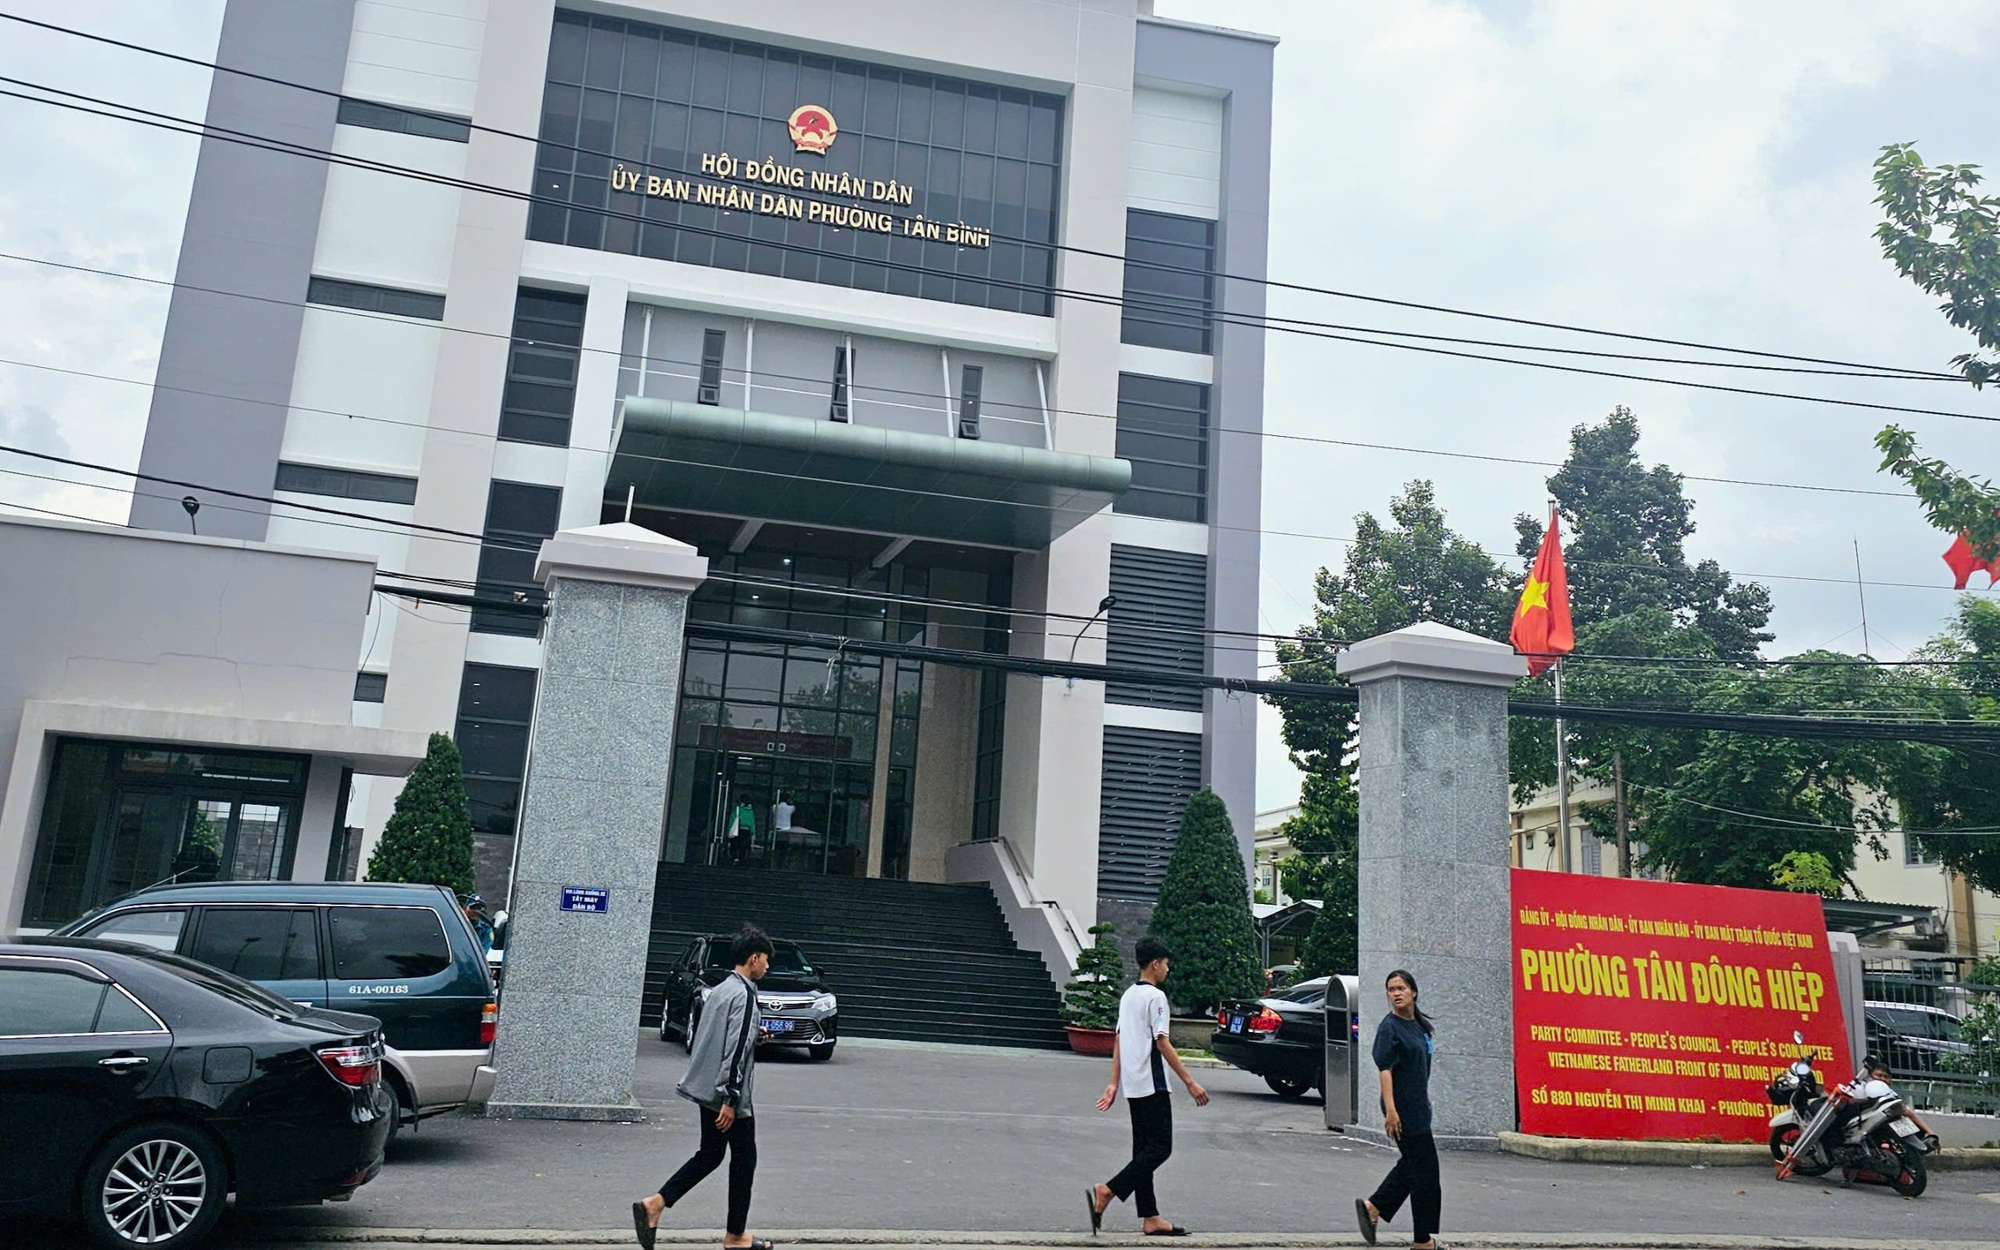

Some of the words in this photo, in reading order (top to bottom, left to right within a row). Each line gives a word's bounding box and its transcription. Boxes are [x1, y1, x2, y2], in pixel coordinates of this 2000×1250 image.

[702, 153, 738, 179] HỘI
[746, 156, 805, 187] ĐỒNG
[811, 171, 866, 197] NHÂN
[872, 179, 913, 205] DÂN
[612, 164, 641, 191] ỦY
[647, 176, 690, 200] BAN
[696, 185, 754, 211] NHÂN
[760, 194, 803, 218] DÂN
[808, 201, 892, 232] PHƯỜNG
[946, 221, 990, 247] BÌNH
[349, 985, 409, 994] 61A-00163
[1520, 942, 1631, 998] PHƯỜNG
[1633, 950, 1688, 1002] TÂN
[1690, 955, 1764, 1008] ĐÔNG
[1766, 962, 1824, 1021] HIỆP
[1530, 1024, 1562, 1042] PARTY
[1564, 1027, 1623, 1046] COMMITTEE
[1630, 1031, 1678, 1050] PEOPLE'S
[1679, 1035, 1722, 1053] COUNCIL
[1731, 1038, 1777, 1056] PEOPLE'S
[1548, 1051, 1612, 1070] VIETNAMESE
[1613, 1056, 1674, 1075] FATHERLAND
[1675, 1060, 1706, 1077] FRONT
[1708, 1063, 1721, 1078] OF
[1721, 1063, 1743, 1079] TAN
[1743, 1065, 1770, 1081] DONG
[1531, 1084, 1548, 1104] SỐ
[1550, 1090, 1573, 1106] 880
[1574, 1088, 1623, 1109] NGUYỄN
[1623, 1094, 1643, 1113] THỊ
[1645, 1096, 1676, 1112] MINH
[1678, 1098, 1706, 1114] KHAI
[1718, 1098, 1765, 1118] PHƯỜNG
